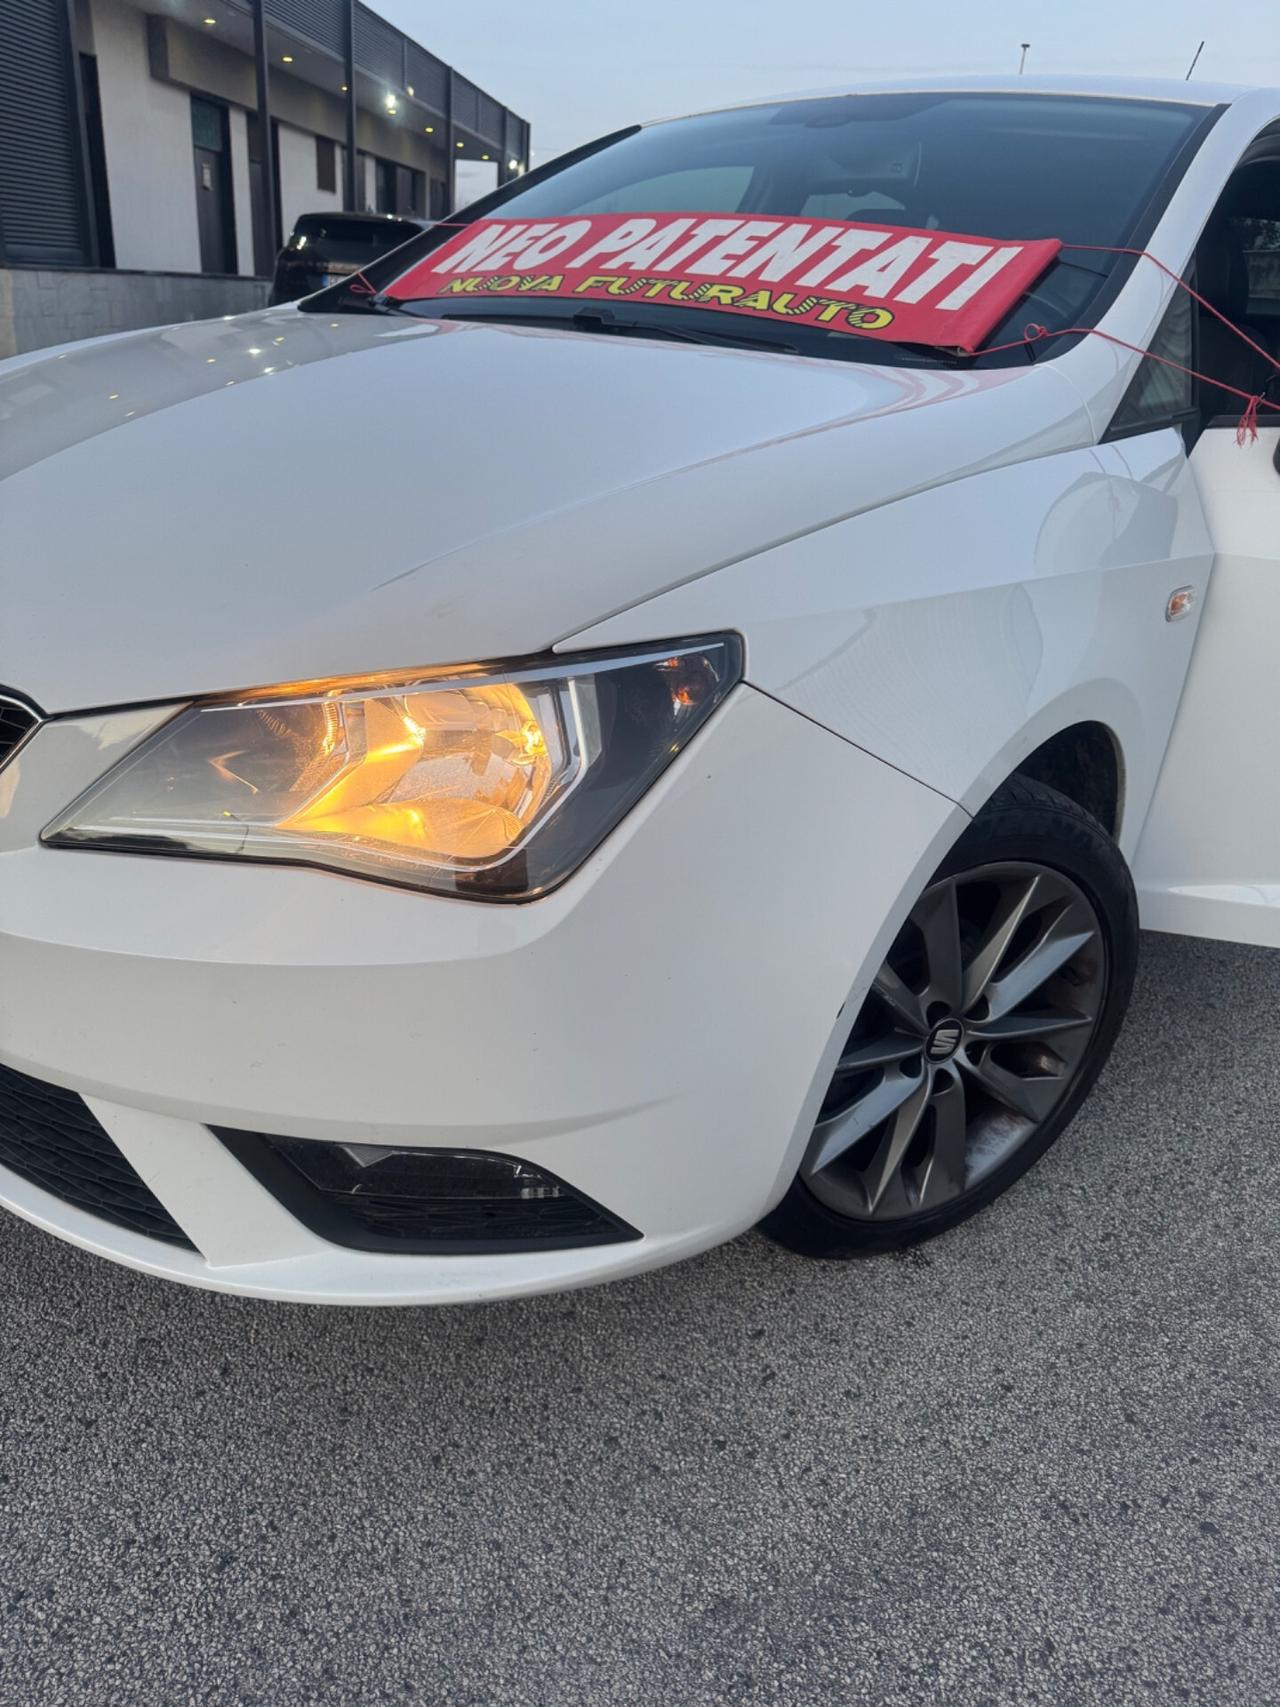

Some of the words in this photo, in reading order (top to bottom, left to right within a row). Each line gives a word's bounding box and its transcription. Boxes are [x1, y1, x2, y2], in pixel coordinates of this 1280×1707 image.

[430, 219, 593, 275] NEO
[565, 217, 1025, 311] PATENTATI
[437, 274, 566, 295] NUOVA
[571, 274, 895, 330] FUTURAUTO
